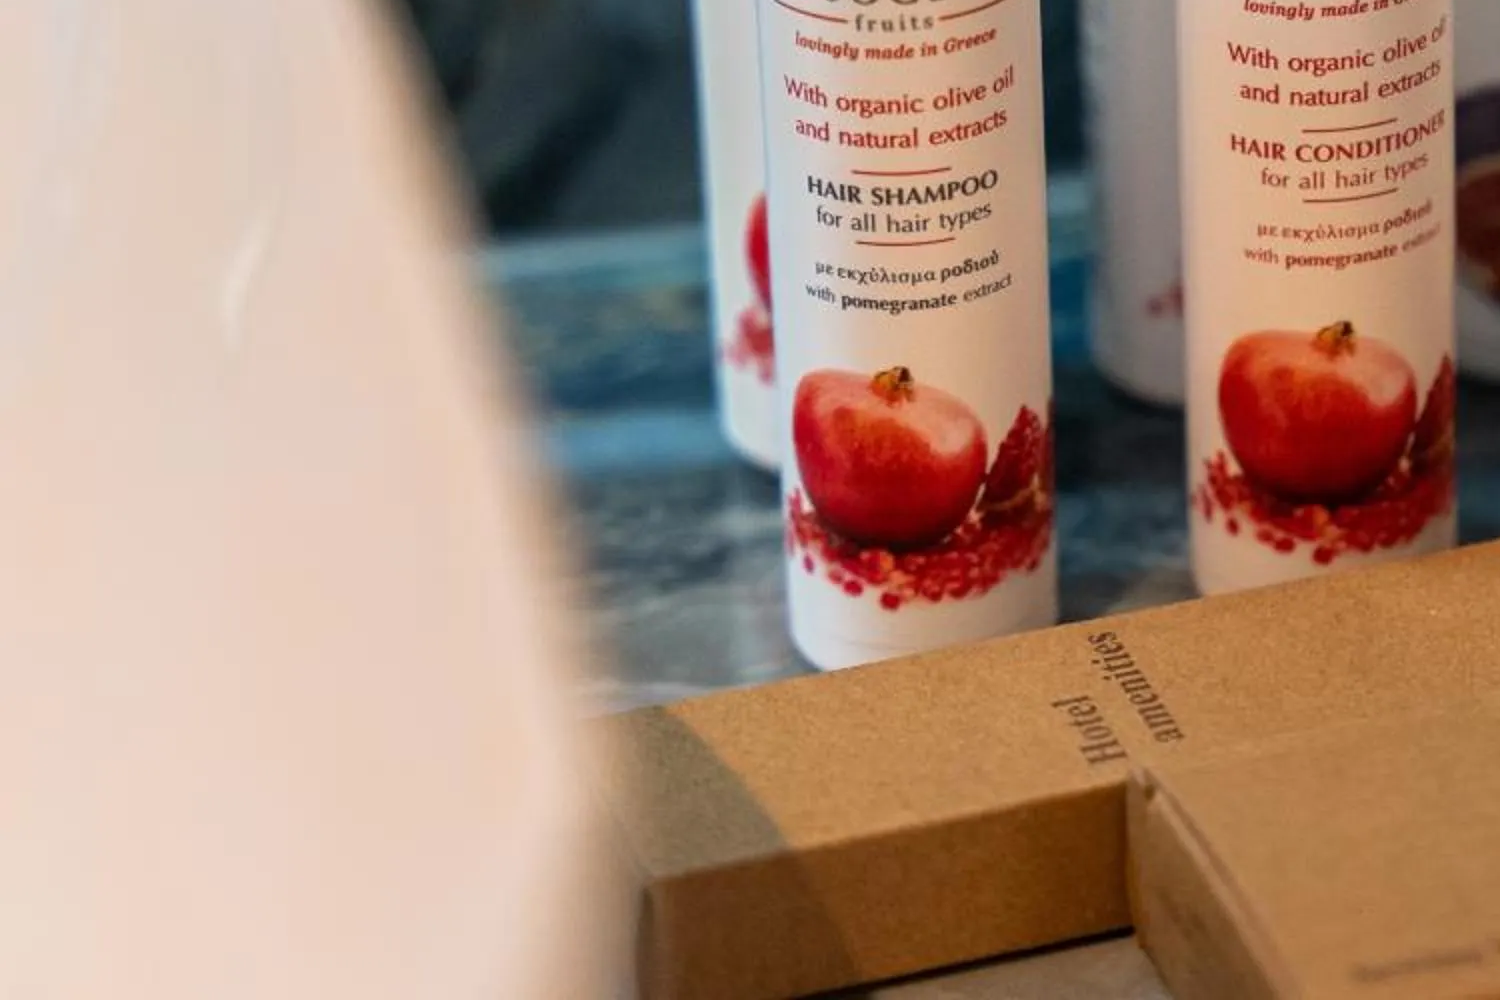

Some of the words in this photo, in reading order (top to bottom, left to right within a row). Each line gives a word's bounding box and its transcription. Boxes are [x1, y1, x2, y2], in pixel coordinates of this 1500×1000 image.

[795, 30, 859, 60] lovingly
[865, 43, 914, 60] made
[920, 41, 937, 56] in
[943, 27, 997, 54] Greece
[855, 14, 934, 33] fruits
[1227, 41, 1278, 70] With
[1288, 49, 1375, 77] organic
[1383, 36, 1426, 63] olive
[784, 75, 827, 109] With
[837, 95, 924, 118] organic
[933, 85, 987, 111] olive
[993, 65, 1015, 93] oil
[1240, 85, 1279, 105] and
[1290, 82, 1368, 107] natural
[1378, 60, 1440, 99] extracts
[796, 117, 829, 143] and
[840, 127, 918, 149] natural
[929, 109, 1007, 146] extracts
[1231, 134, 1285, 161] HAIR
[1296, 108, 1445, 163] CONDITIONER
[807, 175, 861, 204] HAIR
[871, 169, 999, 206] SHAMPOO
[1262, 168, 1288, 188] for
[1300, 168, 1324, 189] all
[1335, 168, 1376, 189] hair
[1384, 152, 1428, 182] types
[816, 207, 842, 227] for
[851, 213, 876, 233] all
[887, 212, 930, 233] hair
[939, 203, 992, 232] types
[816, 262, 833, 275] με
[940, 250, 999, 283] ροδιού
[1245, 248, 1279, 264] with
[1285, 245, 1398, 270] pomegranate
[805, 284, 835, 304] with
[841, 294, 958, 316] pomegranate
[963, 273, 1012, 302] extract
[1088, 632, 1185, 742] amenities
[1052, 696, 1128, 764] Hotel
